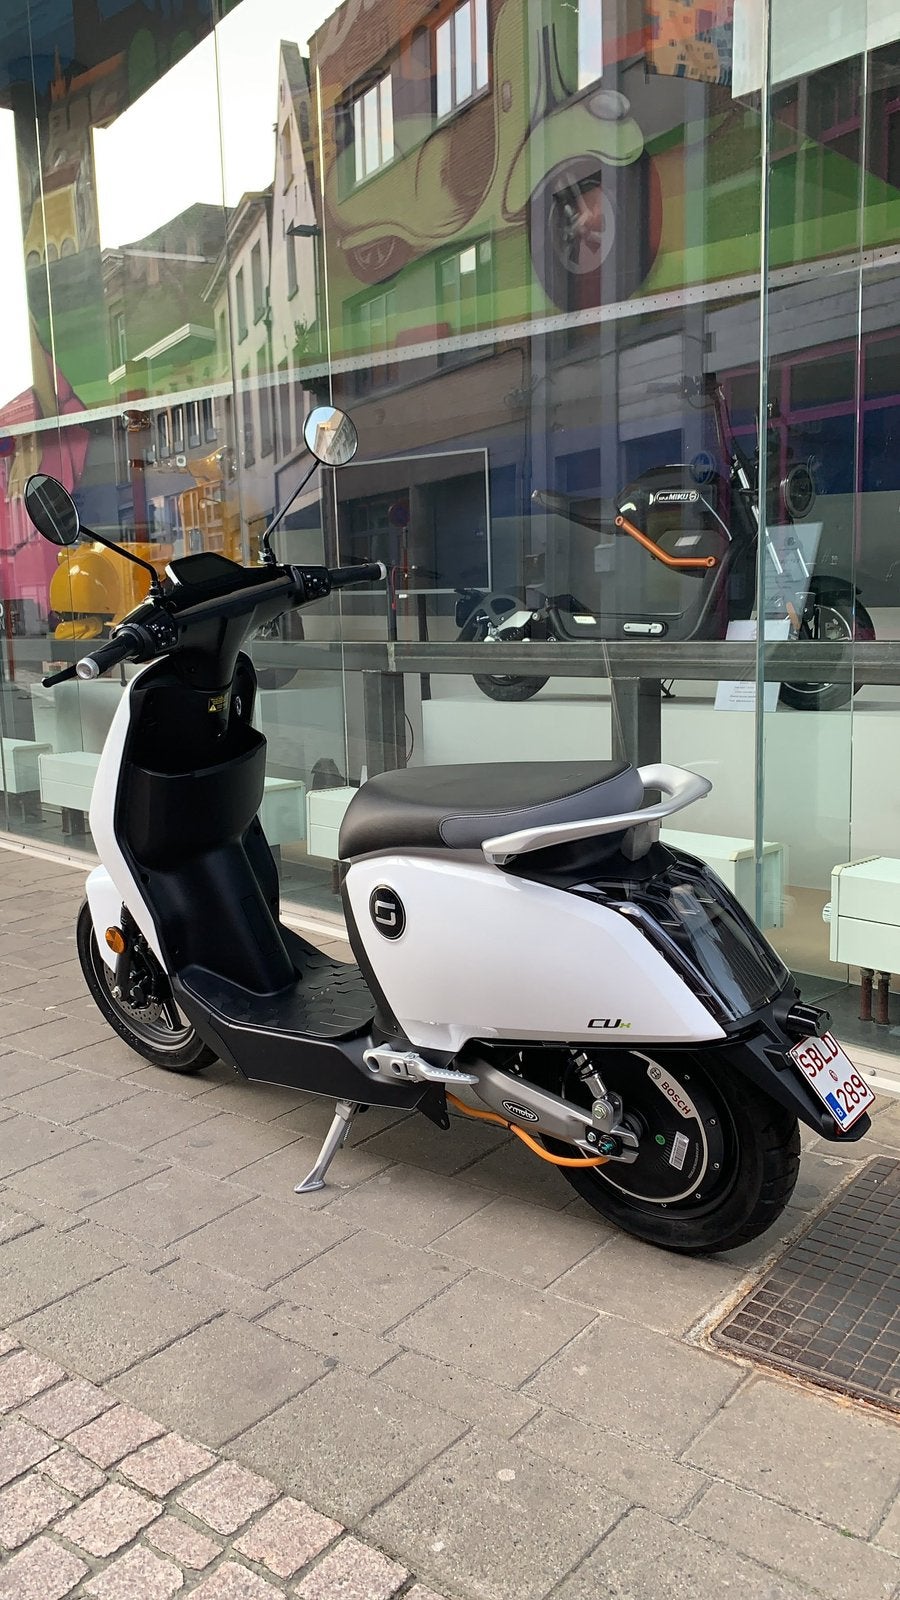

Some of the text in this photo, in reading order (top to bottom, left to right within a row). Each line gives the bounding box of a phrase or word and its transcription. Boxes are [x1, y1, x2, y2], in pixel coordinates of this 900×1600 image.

[799, 1034, 839, 1078] SBLD
[661, 1081, 691, 1115] BOSCH
[836, 1074, 868, 1114] 289
[836, 1108, 844, 1118] B
